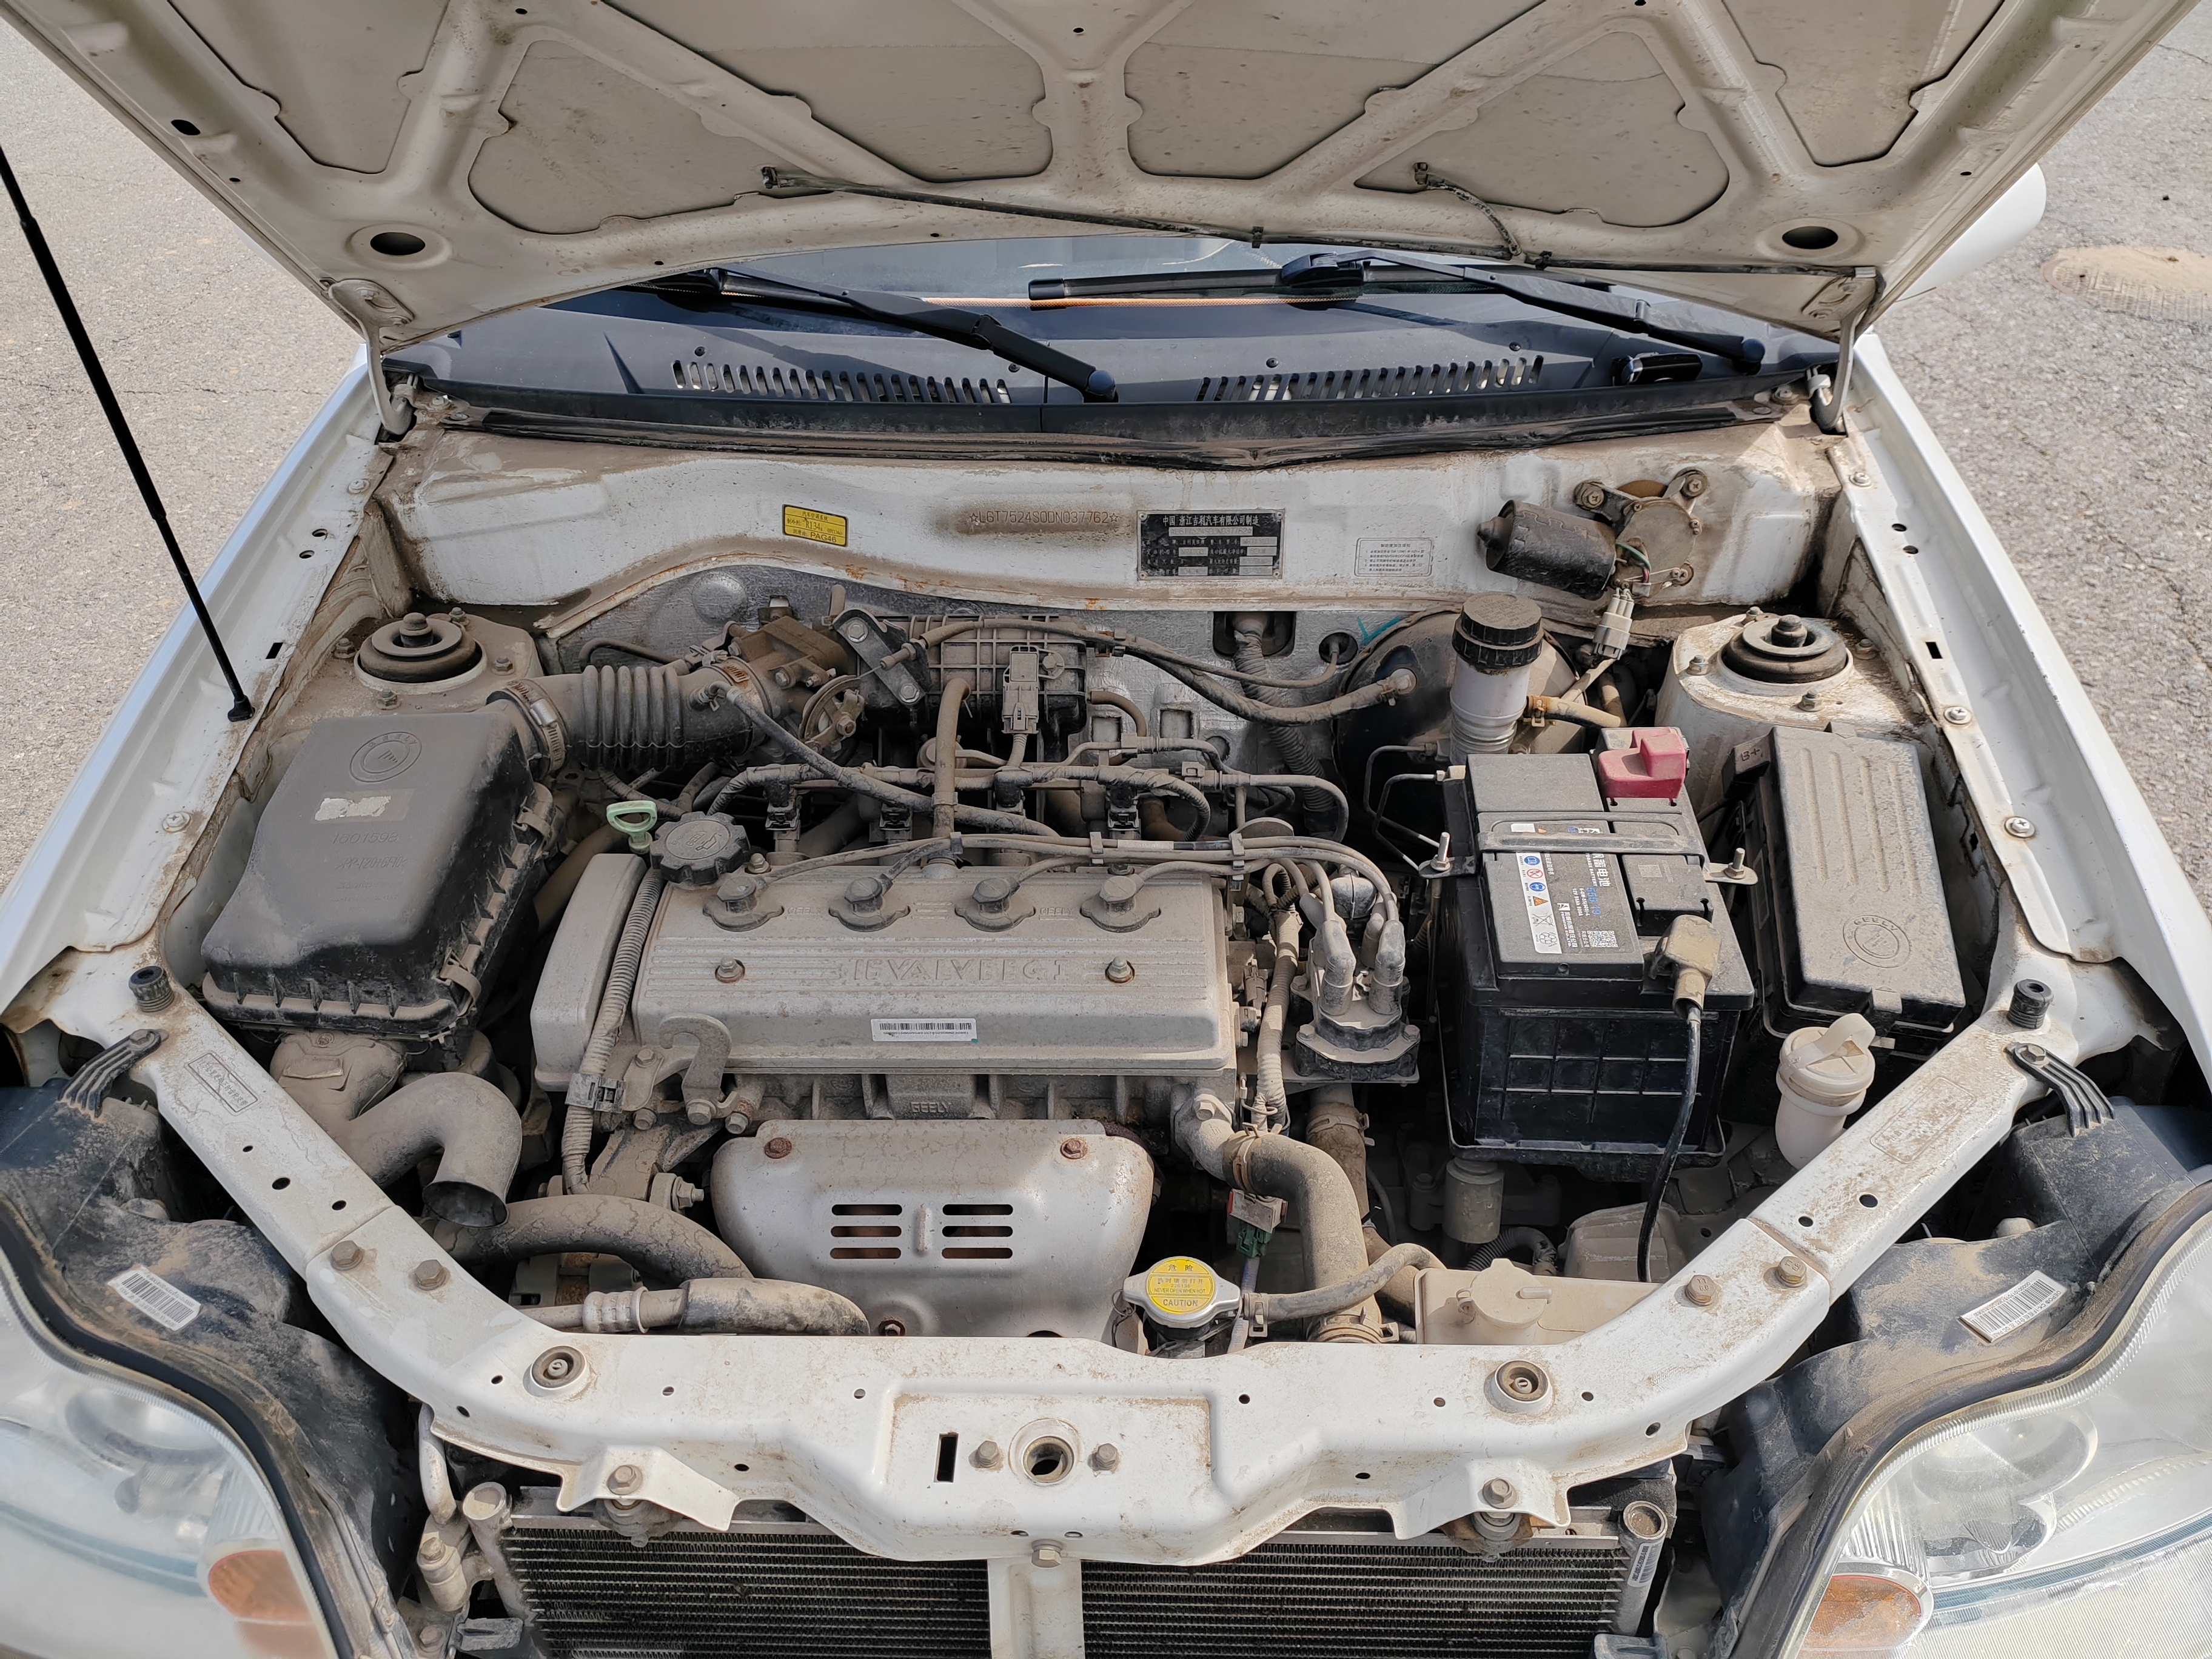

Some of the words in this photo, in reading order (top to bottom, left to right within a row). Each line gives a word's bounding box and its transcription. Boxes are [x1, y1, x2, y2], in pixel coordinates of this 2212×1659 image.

[1162, 515, 1176, 526] 中国
[810, 532, 837, 543] PAG46
[1741, 748, 1760, 762] B+
[1589, 868, 1598, 886] BATTERY
[910, 1101, 949, 1113] GEELY
